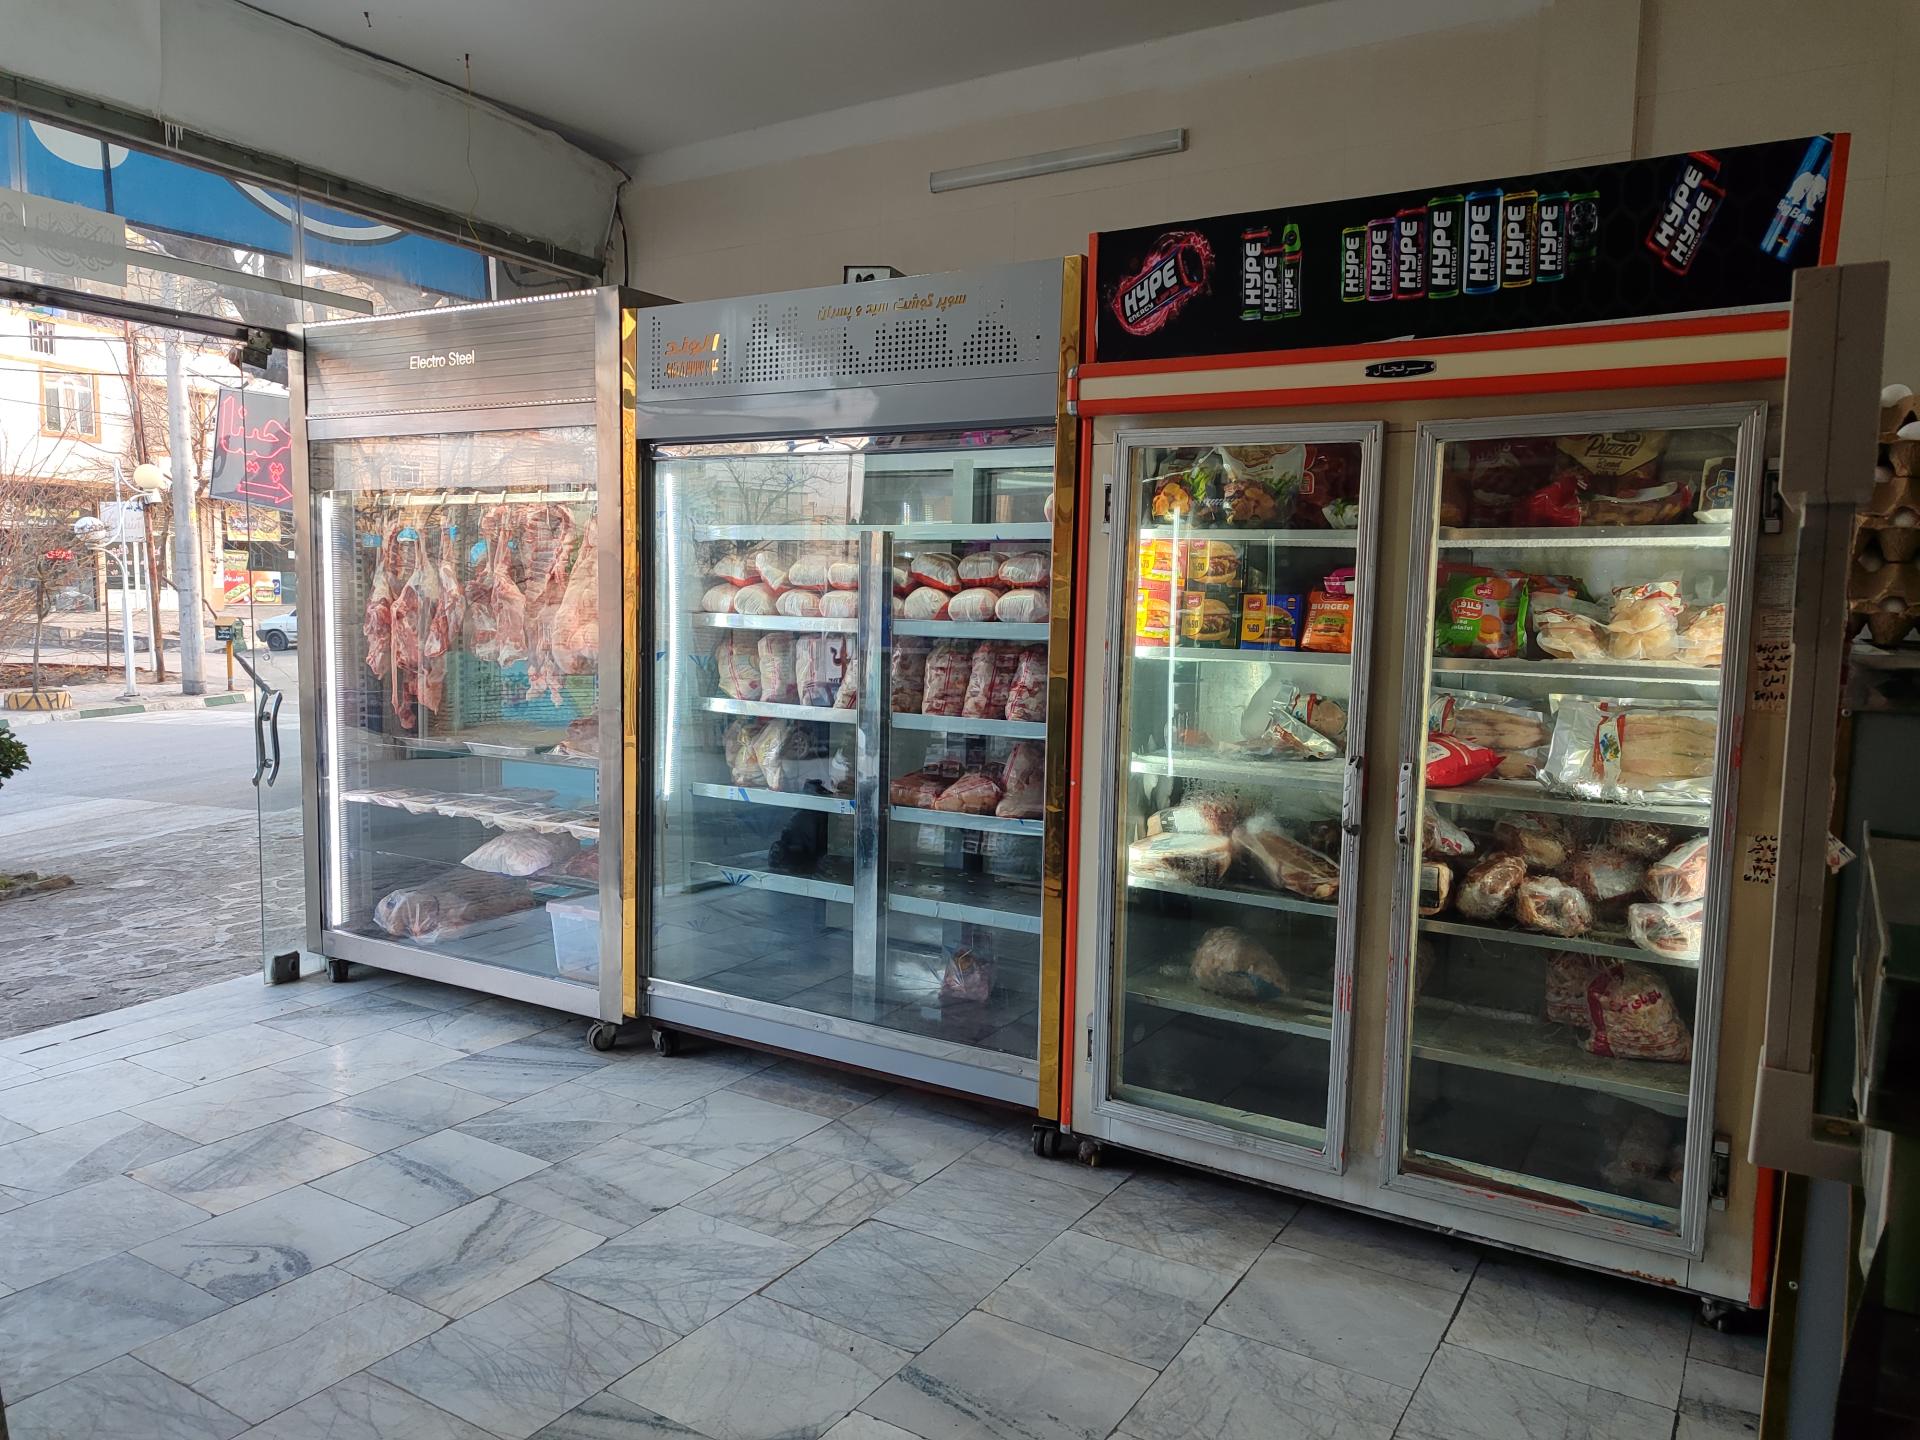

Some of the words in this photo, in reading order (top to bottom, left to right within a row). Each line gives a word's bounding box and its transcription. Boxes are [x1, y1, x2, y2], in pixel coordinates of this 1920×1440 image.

[1539, 205, 1559, 271] HYPE
[1654, 165, 1704, 248] HYPE
[1670, 191, 1713, 263] HYPE
[1345, 237, 1360, 293] HYPE
[1371, 230, 1387, 291] HYPE
[1400, 221, 1418, 288] HYPE
[1432, 210, 1452, 286] HYPE
[1469, 204, 1491, 281] HYPE
[1505, 205, 1526, 276] HYPE
[1123, 258, 1178, 318] HYPE
[1245, 242, 1263, 305] HYPE
[1264, 256, 1278, 313] HYPE
[1284, 268, 1294, 309] HYPE
[409, 355, 446, 370] Electro
[448, 349, 475, 366] Steel
[1584, 434, 1638, 457] Pizza
